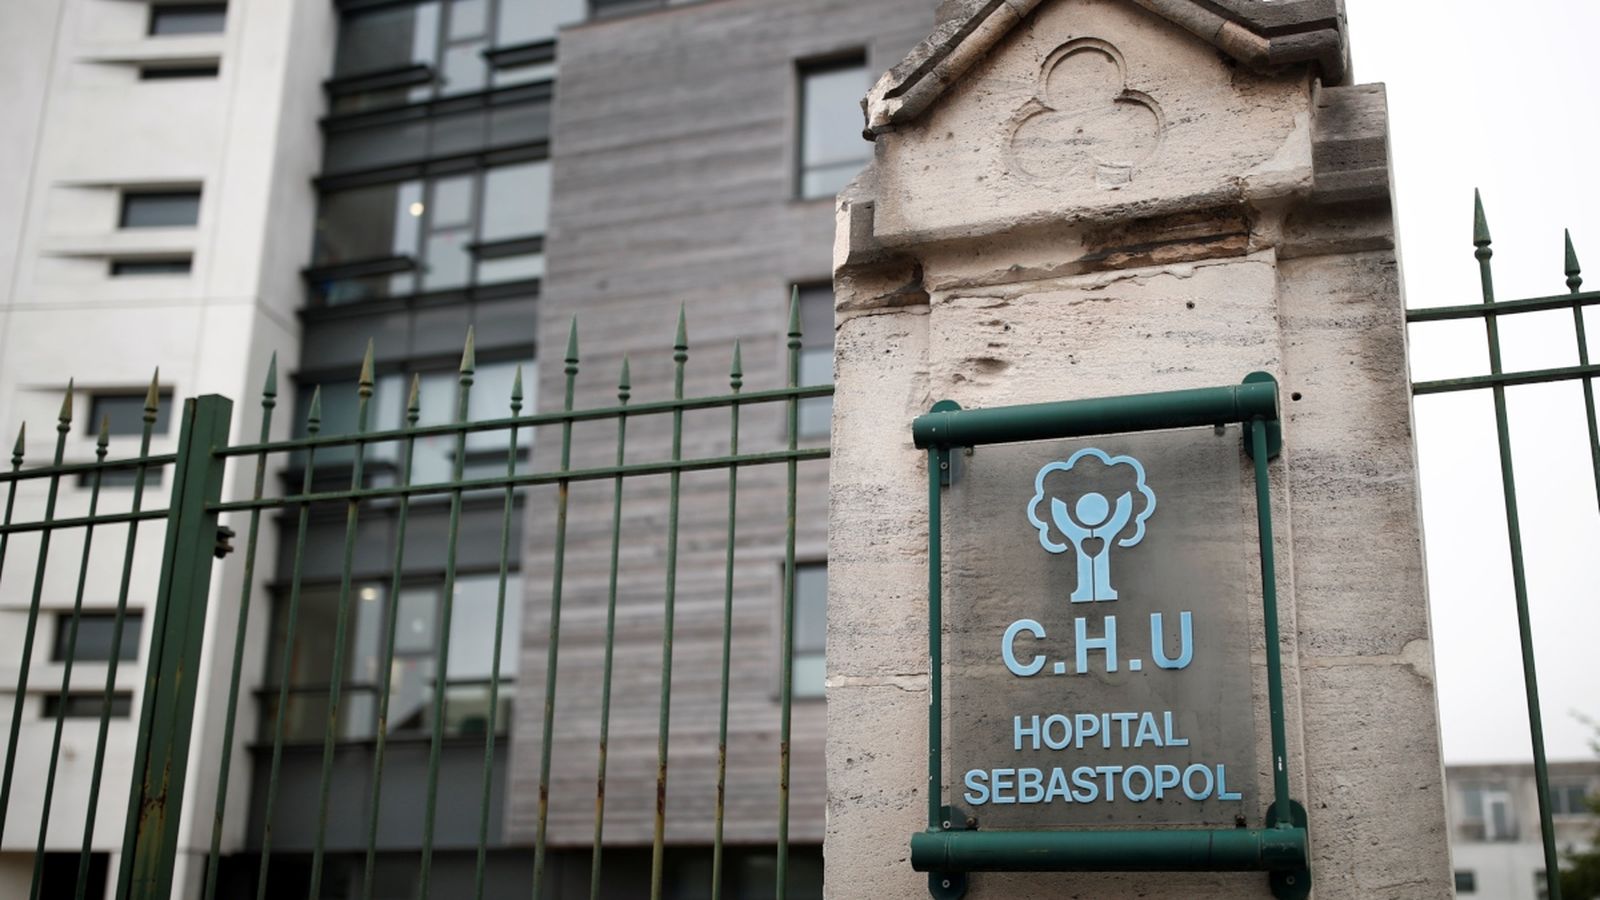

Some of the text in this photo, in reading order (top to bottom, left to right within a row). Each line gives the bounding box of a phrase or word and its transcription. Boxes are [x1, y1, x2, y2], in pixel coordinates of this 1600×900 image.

[1002, 612, 1193, 677] C.H.U
[1013, 711, 1189, 750] HOPITAL
[964, 763, 1242, 805] SEBASTOPOL
